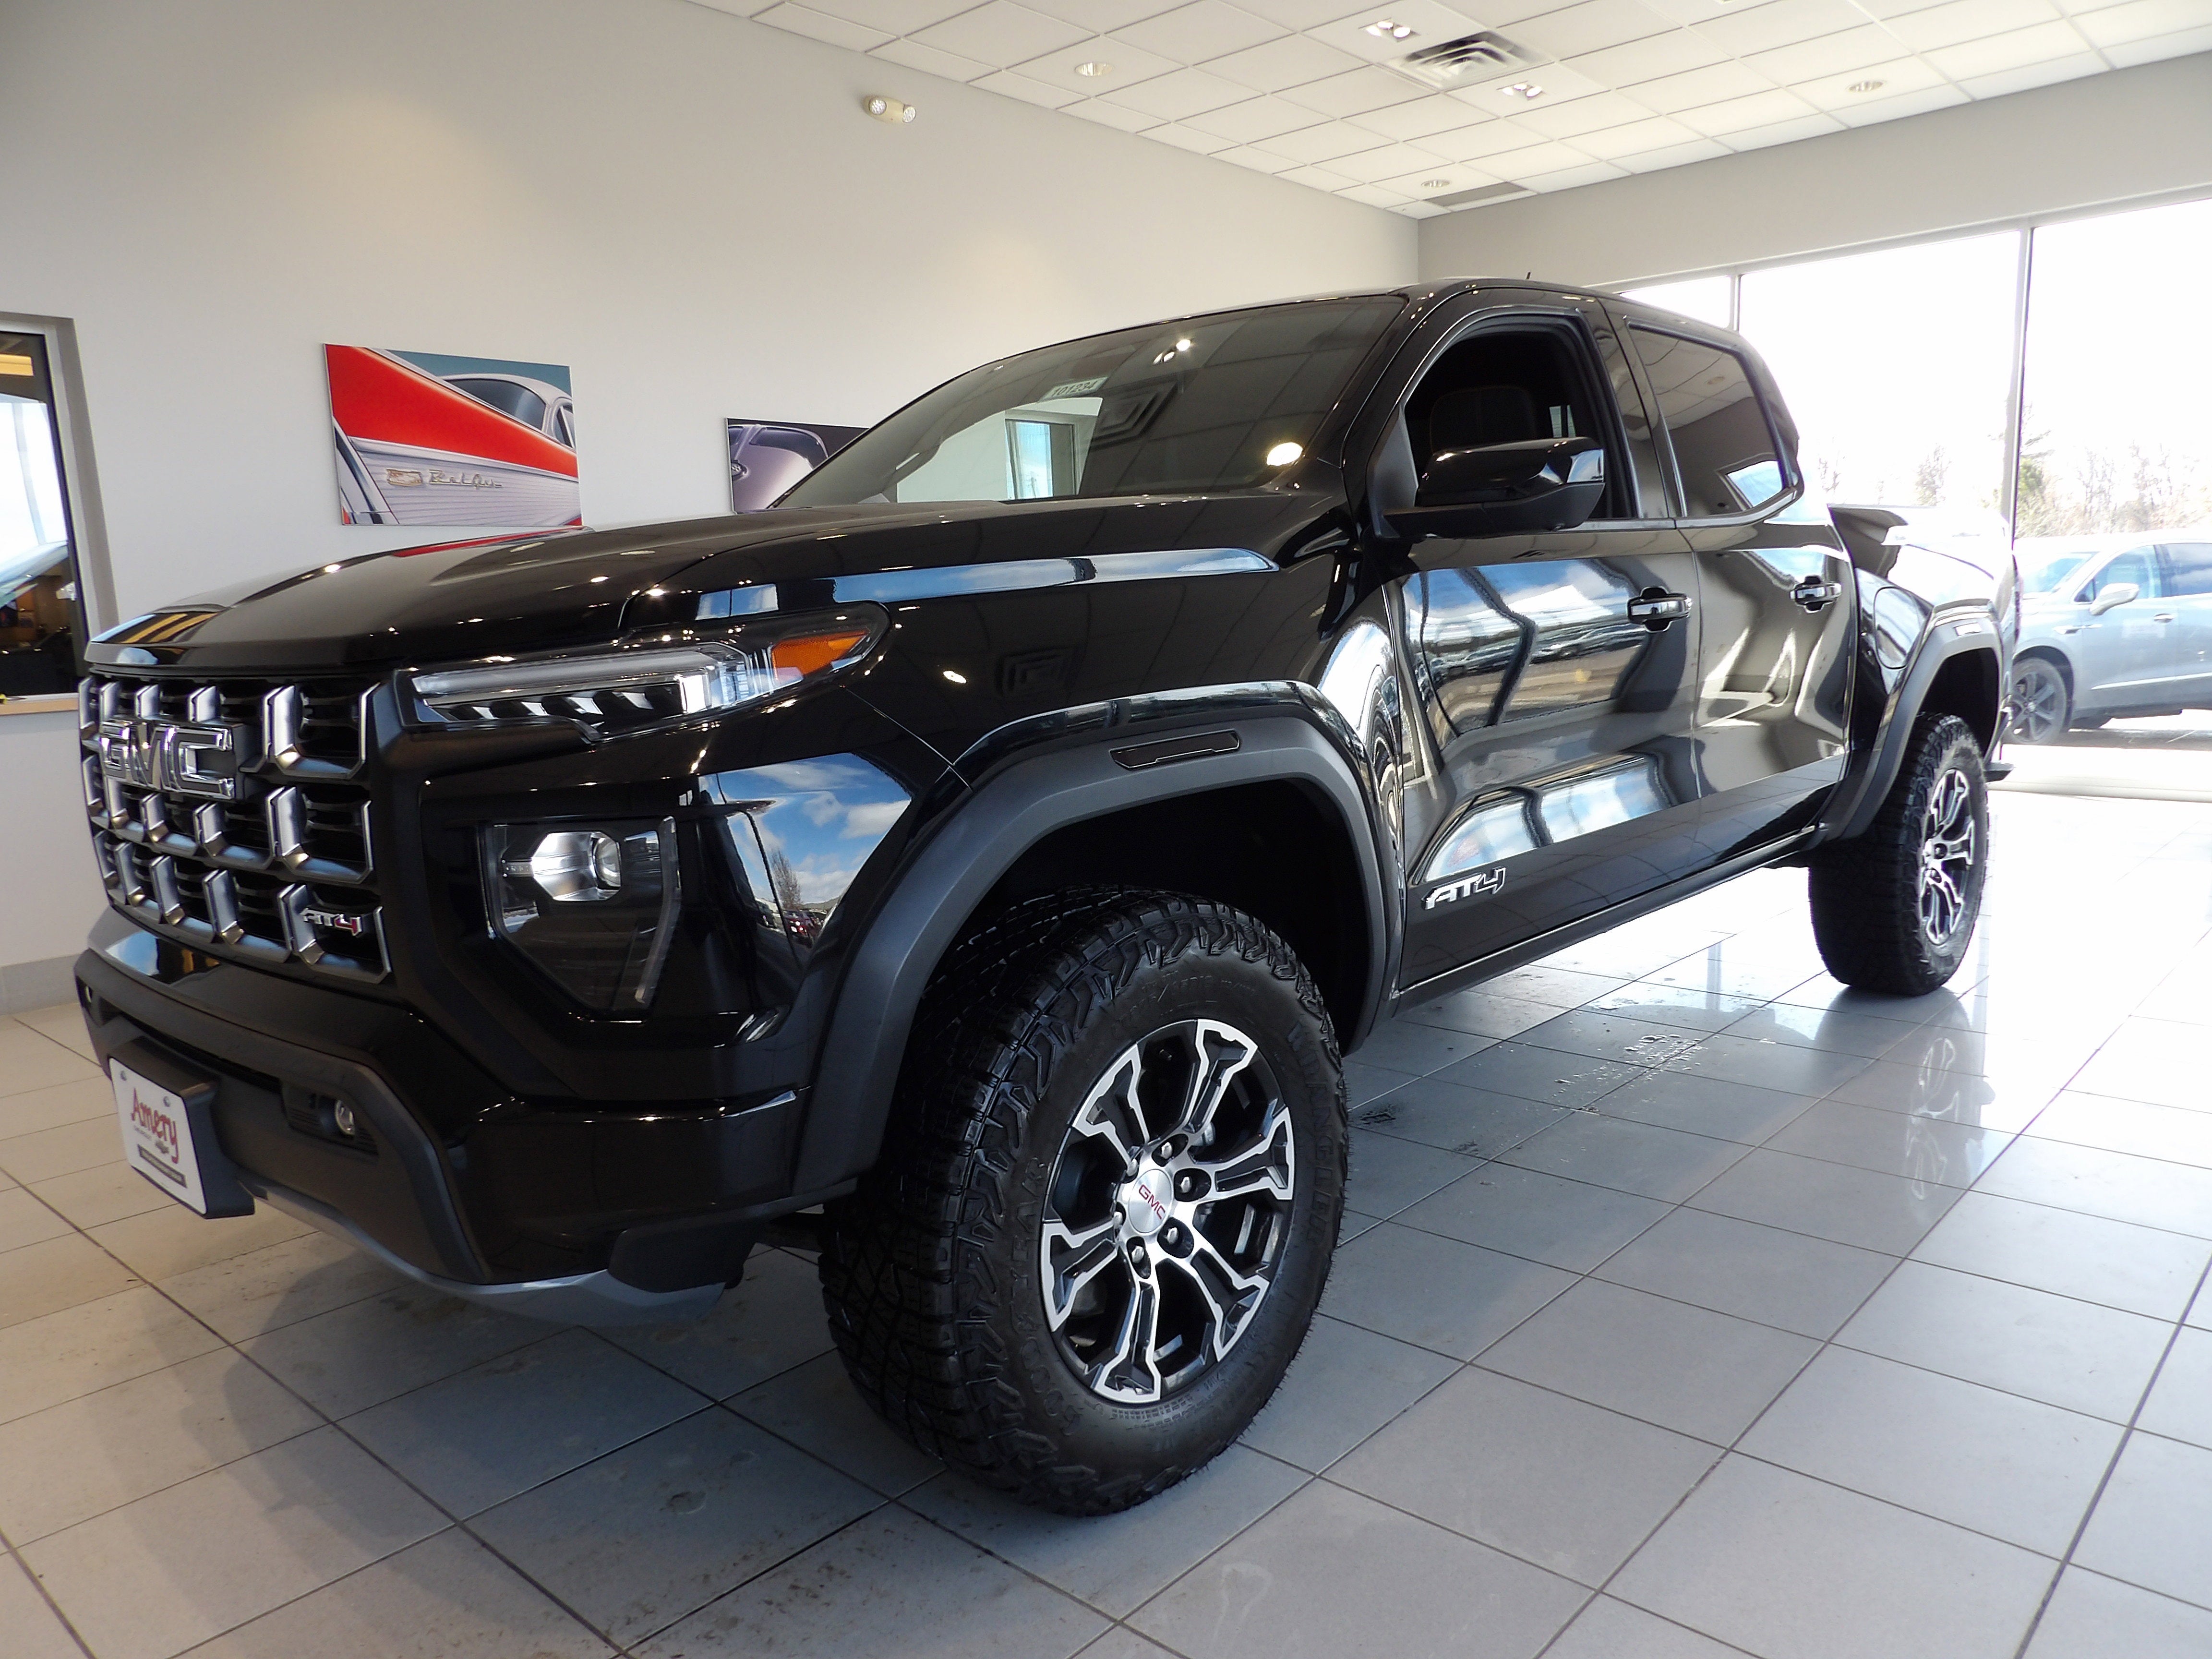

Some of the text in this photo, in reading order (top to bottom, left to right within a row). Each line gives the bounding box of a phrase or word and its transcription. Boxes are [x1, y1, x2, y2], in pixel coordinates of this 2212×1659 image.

[99, 719, 235, 800] GMC
[1421, 866, 1506, 910] AT4
[300, 907, 363, 937] AT4
[131, 1087, 179, 1165] Amery
[1138, 1184, 1166, 1220] GMC
[1010, 1156, 1080, 1436] GOODYEAR
